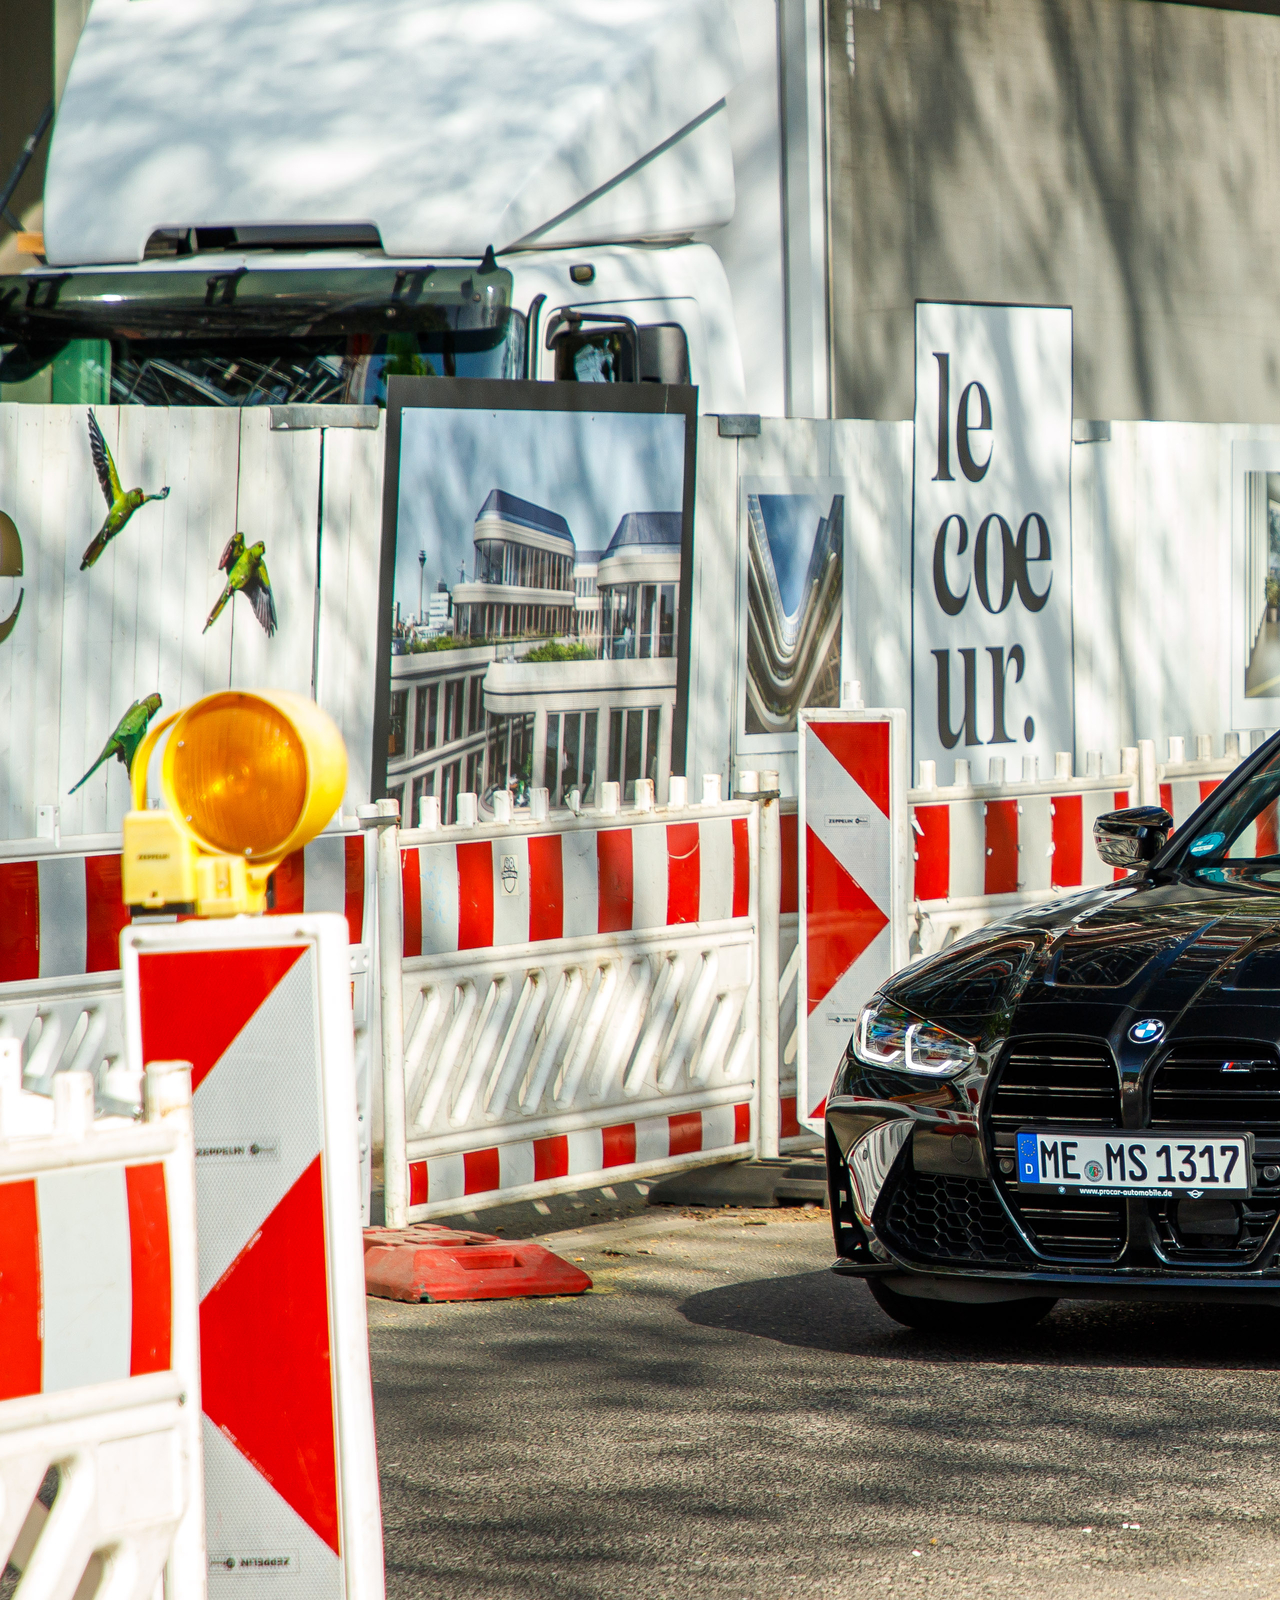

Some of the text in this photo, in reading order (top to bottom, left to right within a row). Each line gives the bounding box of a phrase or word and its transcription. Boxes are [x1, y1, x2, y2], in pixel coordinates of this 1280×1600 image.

[932, 352, 994, 482] le
[931, 644, 1036, 750] ur.
[1025, 1163, 1034, 1175] D
[1040, 1140, 1240, 1183] ME MS 1317
[1079, 1187, 1173, 1197] www.procar-automobile.de
